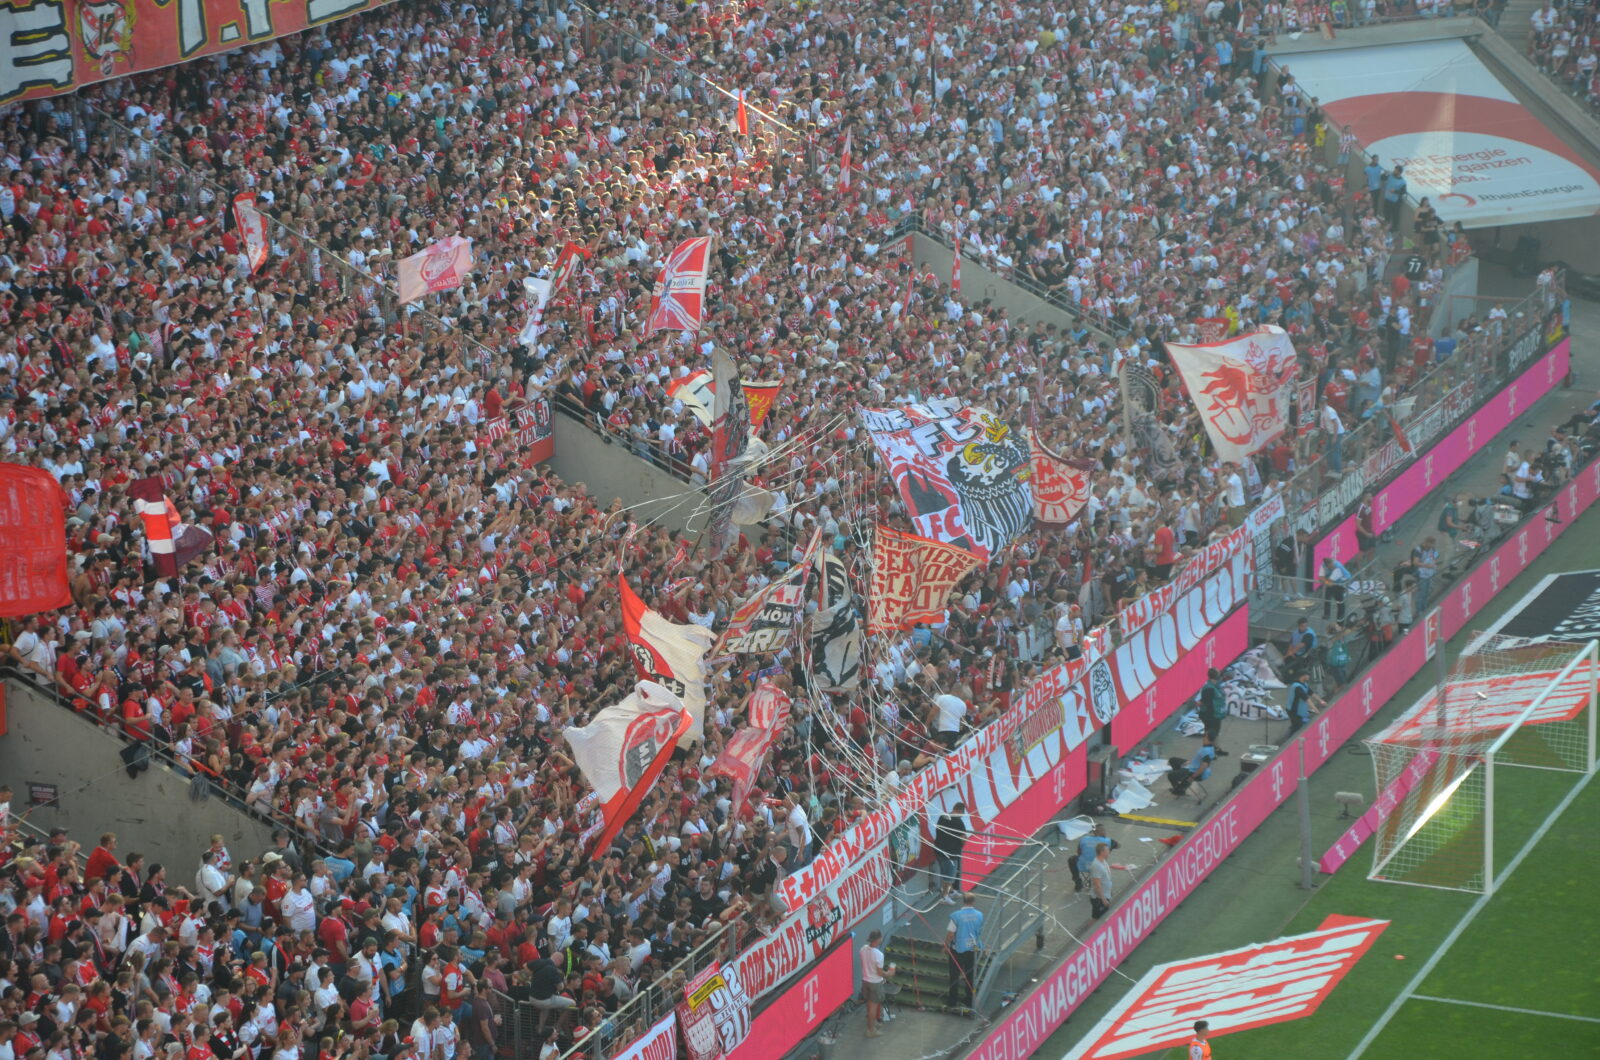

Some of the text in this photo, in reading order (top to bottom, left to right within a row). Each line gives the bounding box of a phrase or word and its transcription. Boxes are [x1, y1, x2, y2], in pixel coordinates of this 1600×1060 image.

[1392, 148, 1507, 168] Die Energie
[1457, 156, 1532, 174] ganzen
[1478, 183, 1585, 202] RheinEnergie
[1025, 662, 1065, 718] ROSE
[1362, 677, 1373, 716] T
[1318, 717, 1330, 757] T
[1053, 762, 1066, 804] T
[1271, 760, 1284, 802] T
[1040, 931, 1119, 1033] MAGENTA
[1118, 883, 1165, 961] MOBIL
[1165, 804, 1239, 904] ANGEBOTE
[803, 974, 819, 1020] T
